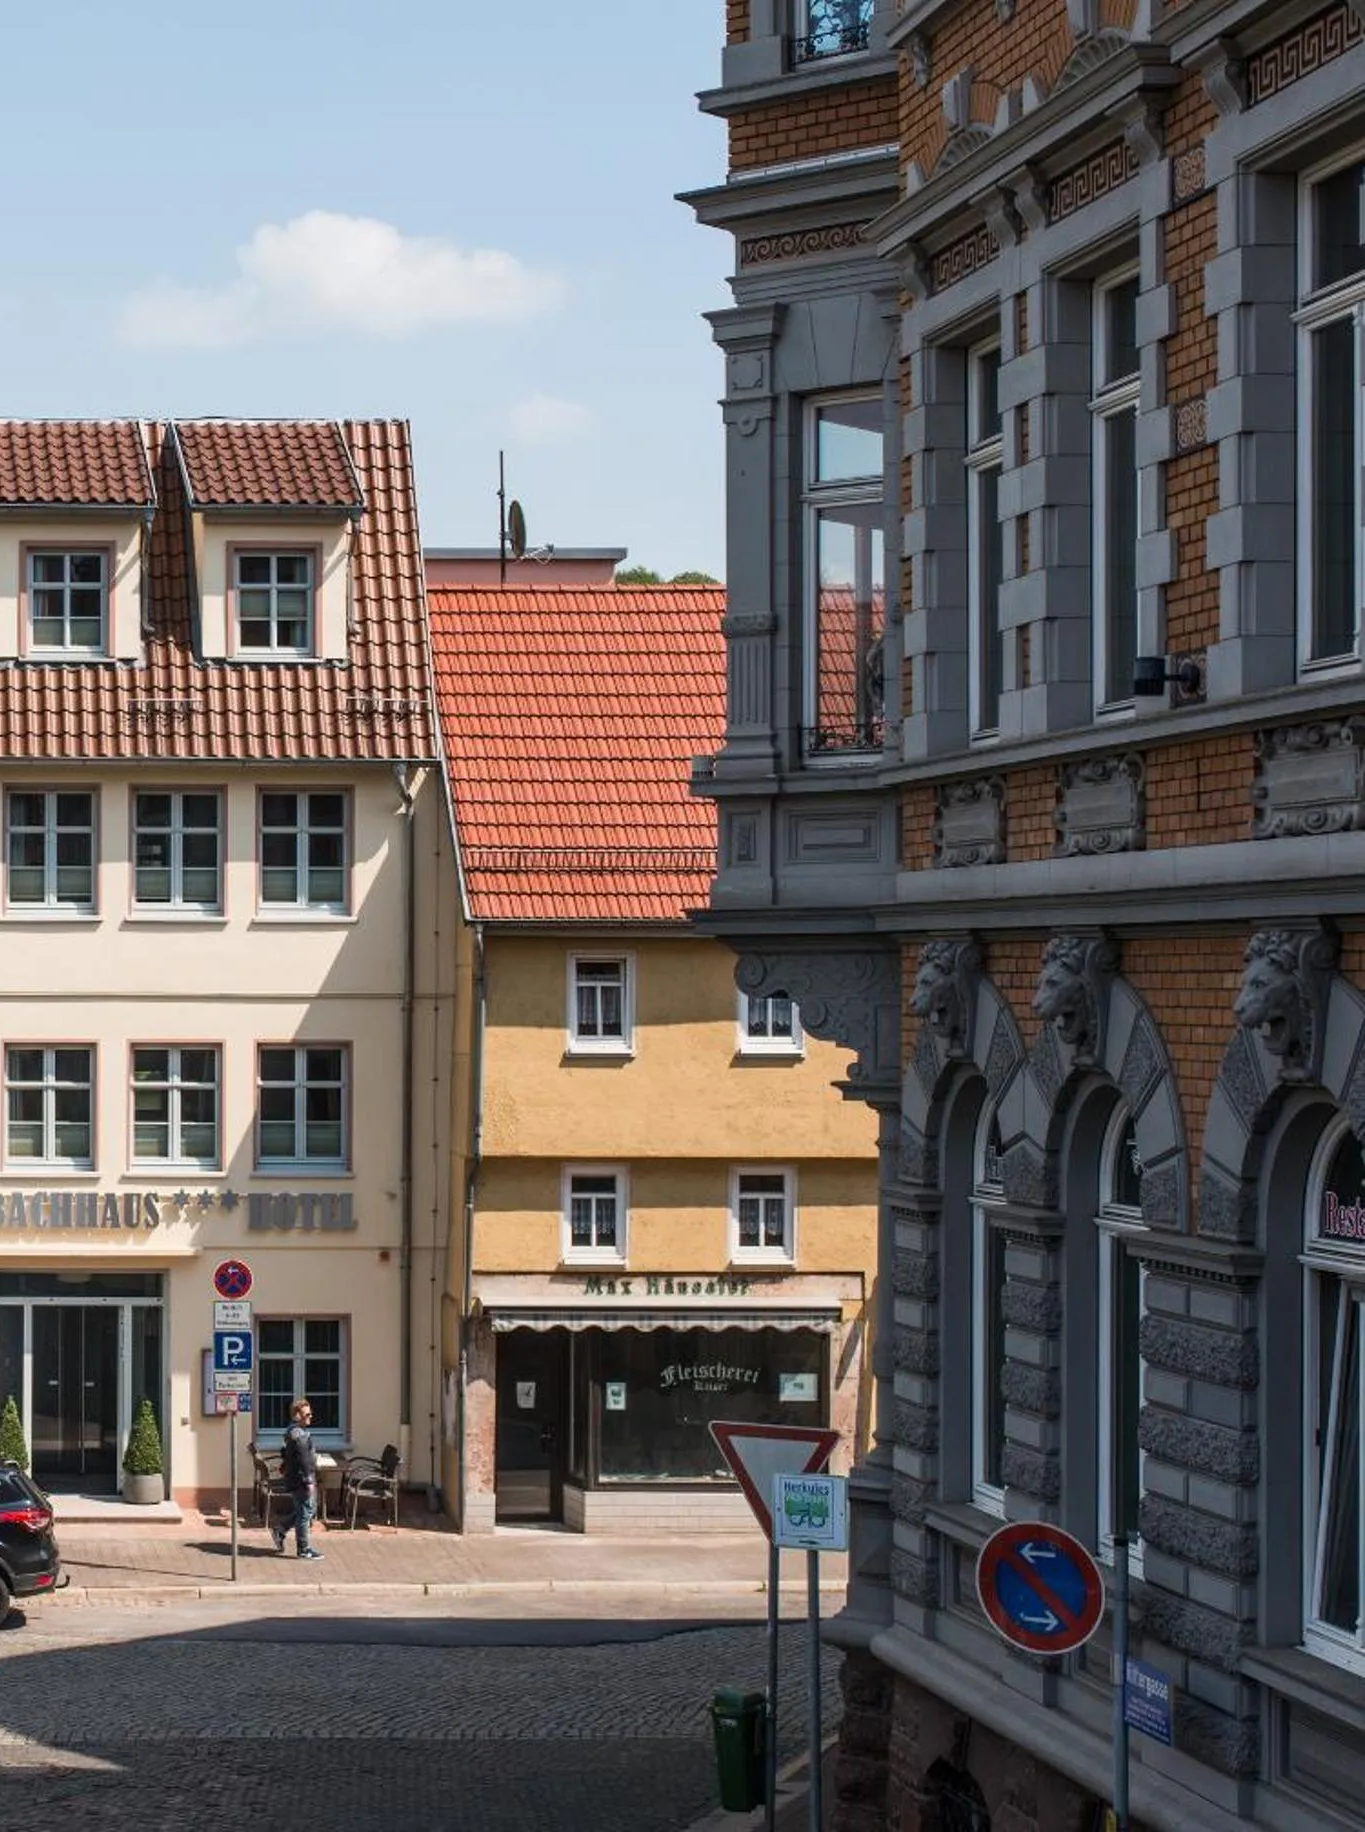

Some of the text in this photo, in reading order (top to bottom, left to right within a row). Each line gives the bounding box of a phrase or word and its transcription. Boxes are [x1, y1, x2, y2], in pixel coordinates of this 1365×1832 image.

[247, 1192, 356, 1230] HOTEL
[585, 1275, 633, 1295] Max
[222, 1336, 244, 1366] P
[659, 1361, 762, 1388] Fleischerei
